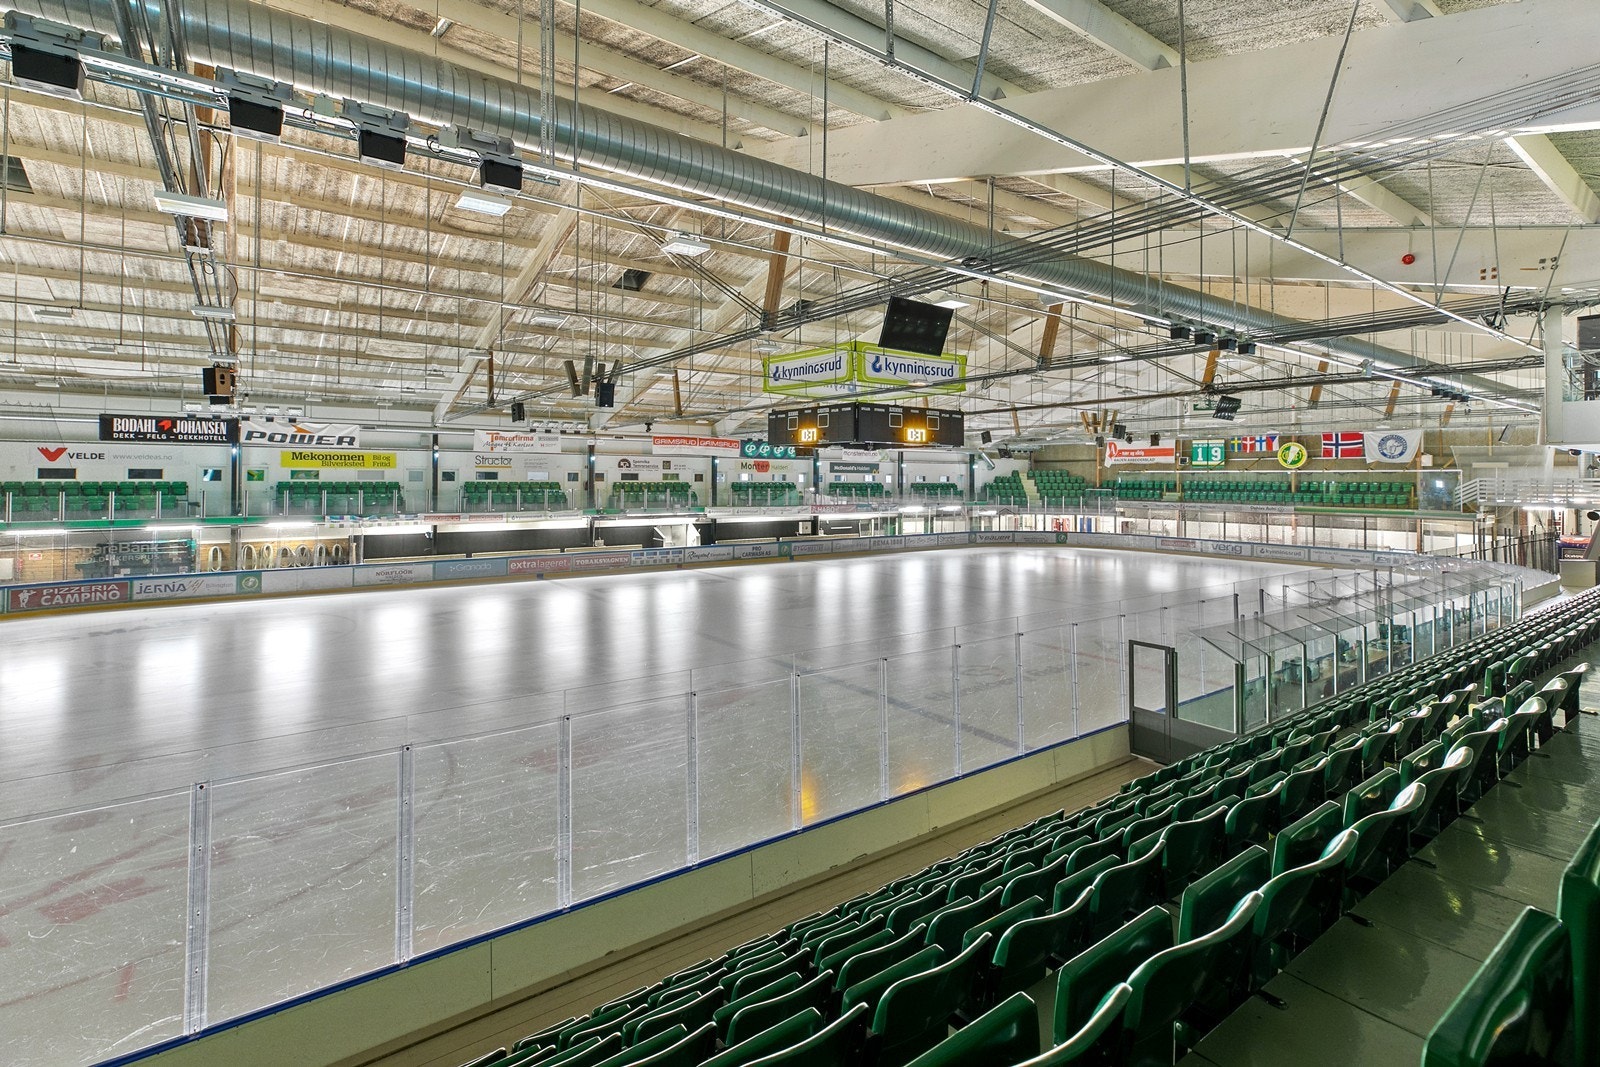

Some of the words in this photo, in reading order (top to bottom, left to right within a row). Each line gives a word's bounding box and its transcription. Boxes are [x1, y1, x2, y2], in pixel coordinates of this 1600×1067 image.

[781, 356, 842, 380] kynningsrud
[884, 357, 954, 378] kynningsrud
[112, 417, 159, 433] BODAHL
[173, 420, 227, 435] JOHANSEN
[244, 430, 356, 446] POWER
[654, 438, 697, 446] GRIMSRUD
[699, 440, 739, 448] GRIMSRUD
[68, 452, 105, 460] VELDE
[291, 451, 365, 461] Mekonomen
[475, 454, 513, 466] Structor
[1197, 447, 1204, 461] 1
[1211, 447, 1221, 461] 9
[740, 462, 769, 470] Monter
[42, 584, 120, 596] PIZZERIA
[40, 590, 121, 606] CAMPINO
